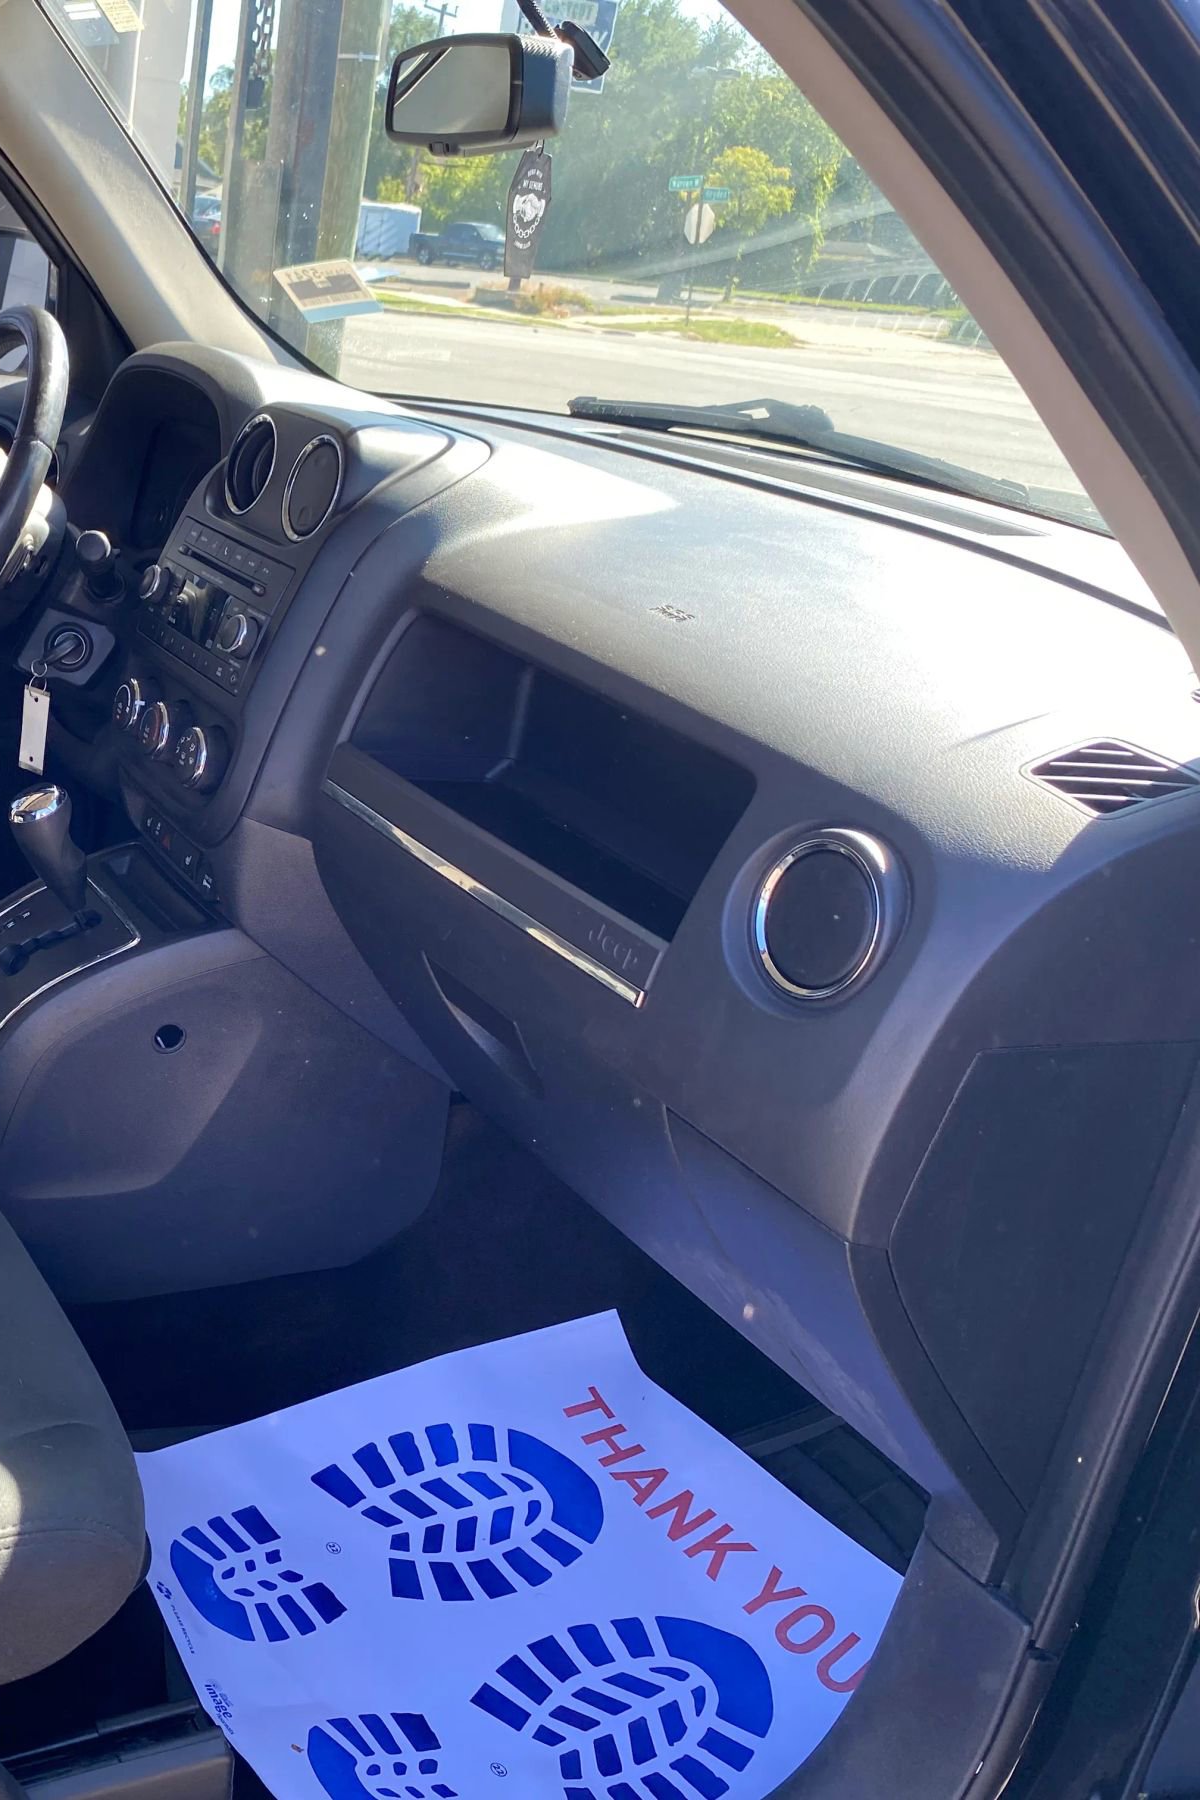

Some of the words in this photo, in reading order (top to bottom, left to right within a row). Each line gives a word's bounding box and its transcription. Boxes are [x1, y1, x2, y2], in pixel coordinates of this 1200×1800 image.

[562, 1386, 758, 1582] THANK
[742, 1565, 872, 1693] YOU
[205, 1684, 232, 1720] image
